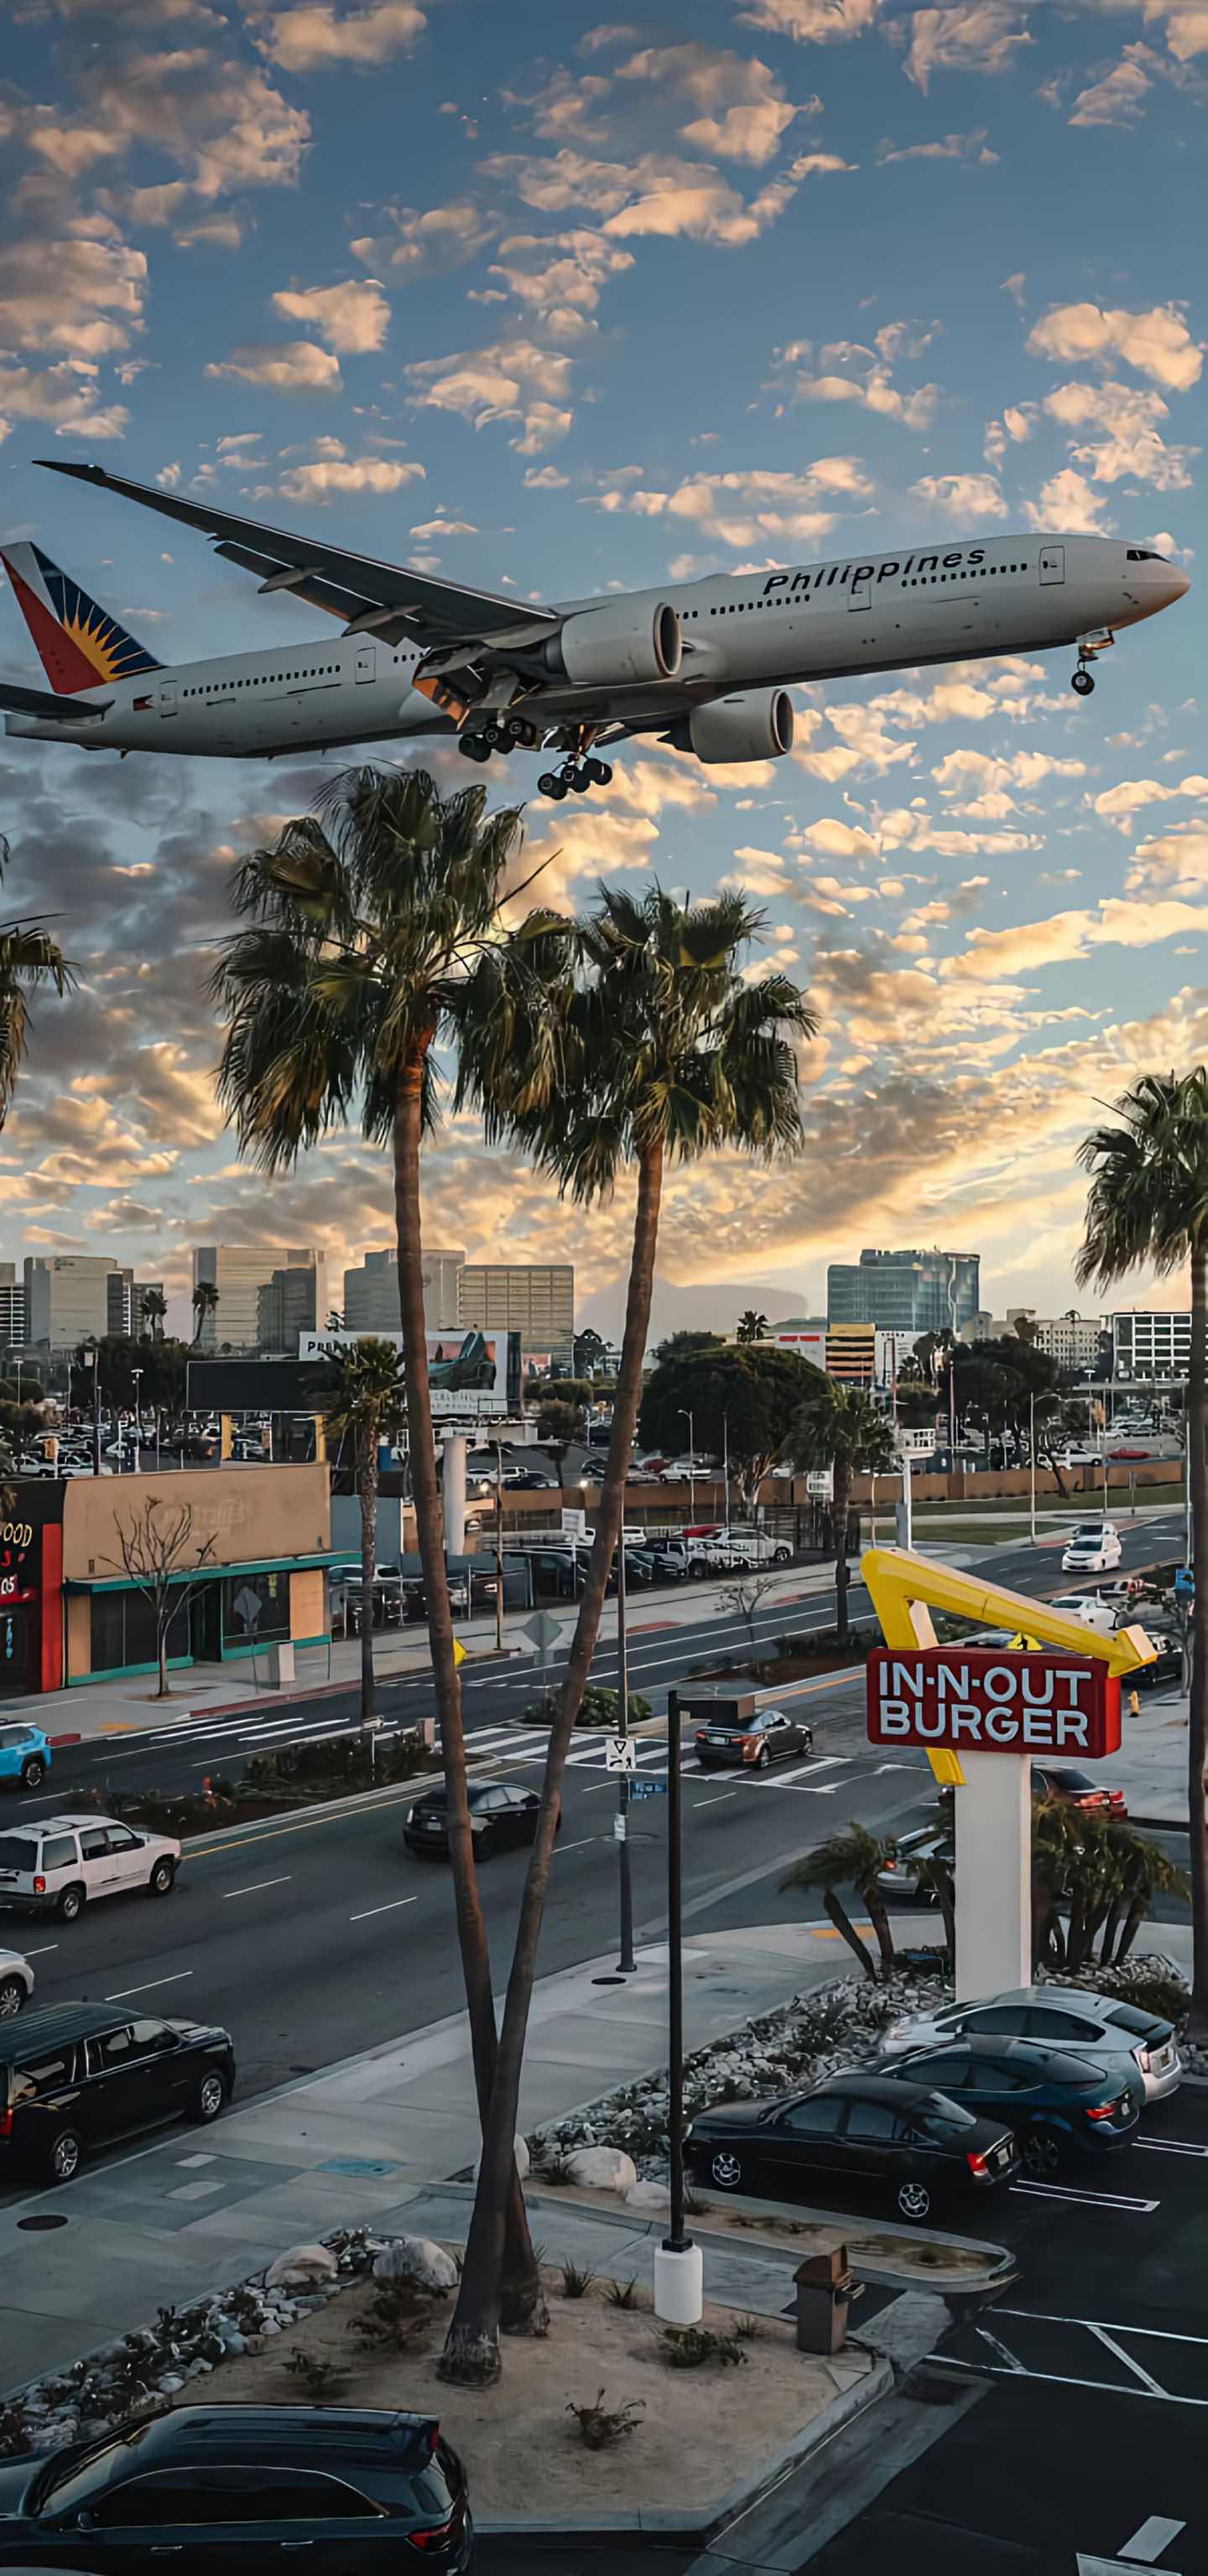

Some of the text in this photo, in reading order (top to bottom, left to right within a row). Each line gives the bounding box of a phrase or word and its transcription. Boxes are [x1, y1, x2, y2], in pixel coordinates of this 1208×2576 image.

[763, 549, 986, 595] Philippines
[879, 1661, 1091, 1706] IN-N-OUT
[879, 1700, 1089, 1747] BURGER
